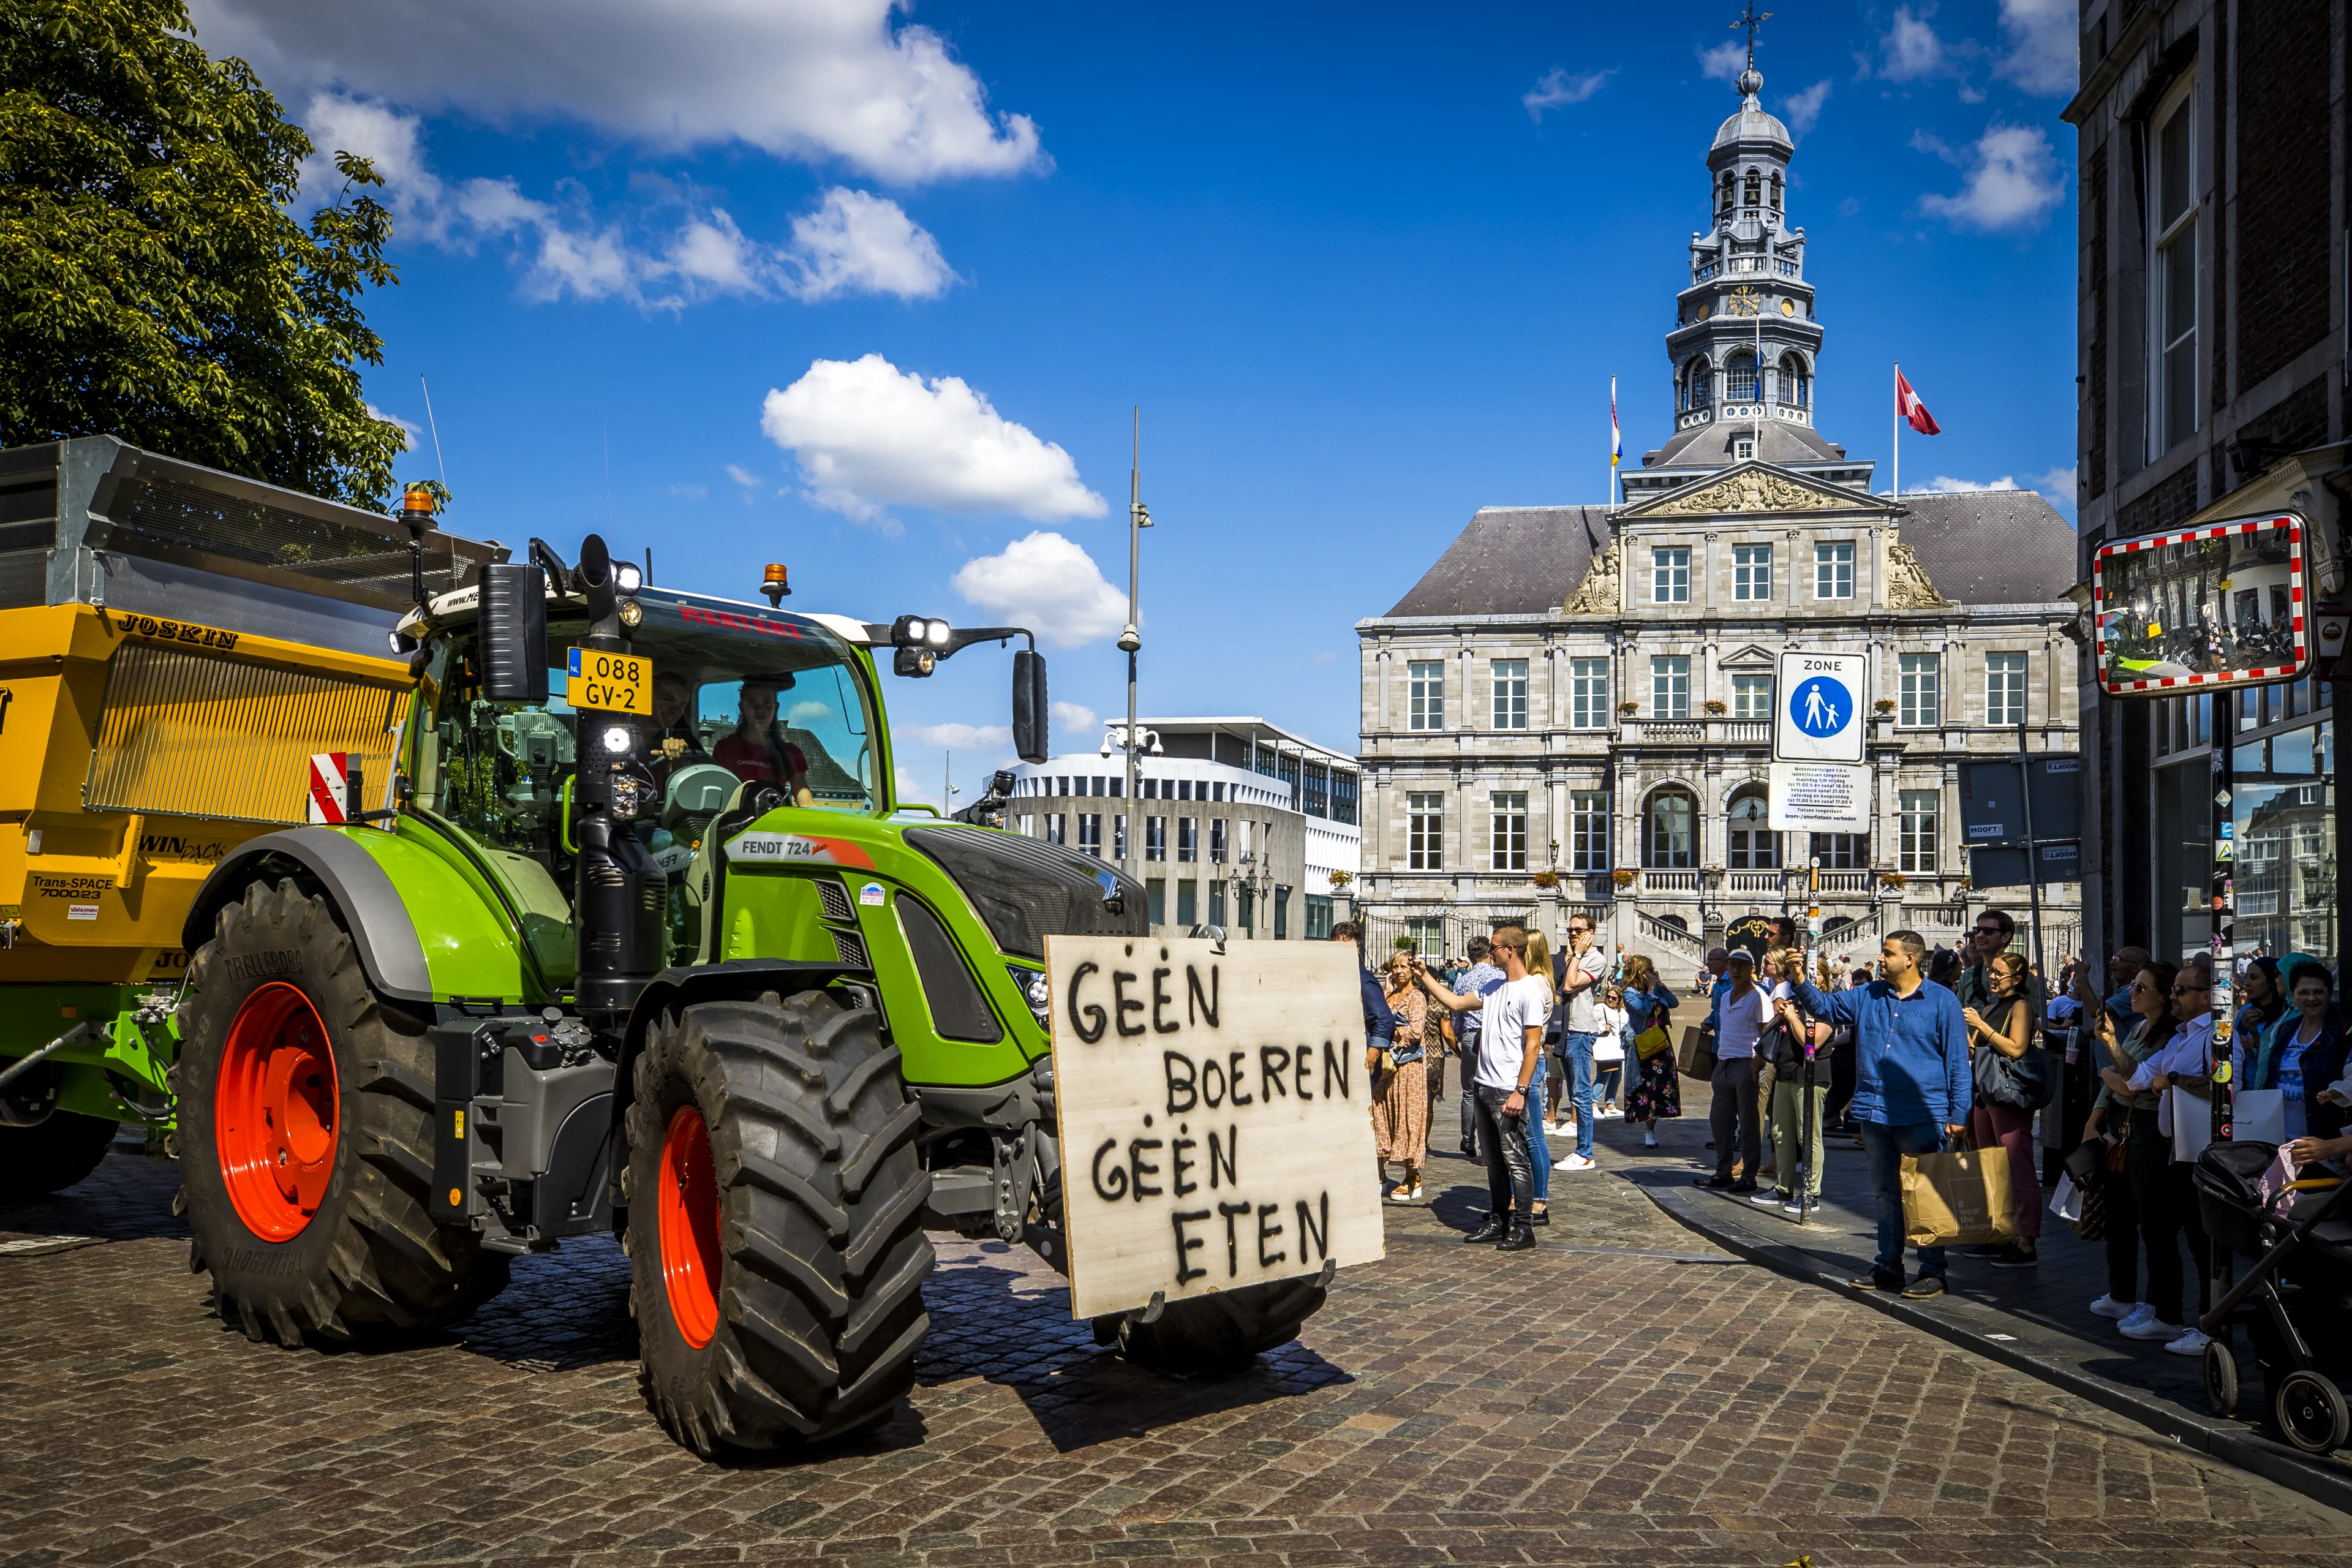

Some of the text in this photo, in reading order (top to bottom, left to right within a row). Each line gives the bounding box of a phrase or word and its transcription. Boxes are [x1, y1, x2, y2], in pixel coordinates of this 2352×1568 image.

[117, 613, 239, 650] JOSKIN
[677, 605, 802, 639] MERTENS
[597, 657, 639, 682] 088
[1804, 660, 1841, 671] ZONE
[586, 683, 635, 709] GV-2
[742, 841, 783, 854] FENDT
[787, 842, 810, 856] 724
[33, 876, 113, 890] Trans-SPACE
[40, 888, 101, 900] 7000/23
[224, 949, 303, 982] TRELLEBORG
[188, 1062, 200, 1088] R
[194, 1011, 211, 1056] 38
[1164, 1039, 1349, 1117] BOEREN
[1960, 1215, 1974, 1224] the
[1961, 1223, 1991, 1231] change
[1171, 1190, 1330, 1287] ETEN
